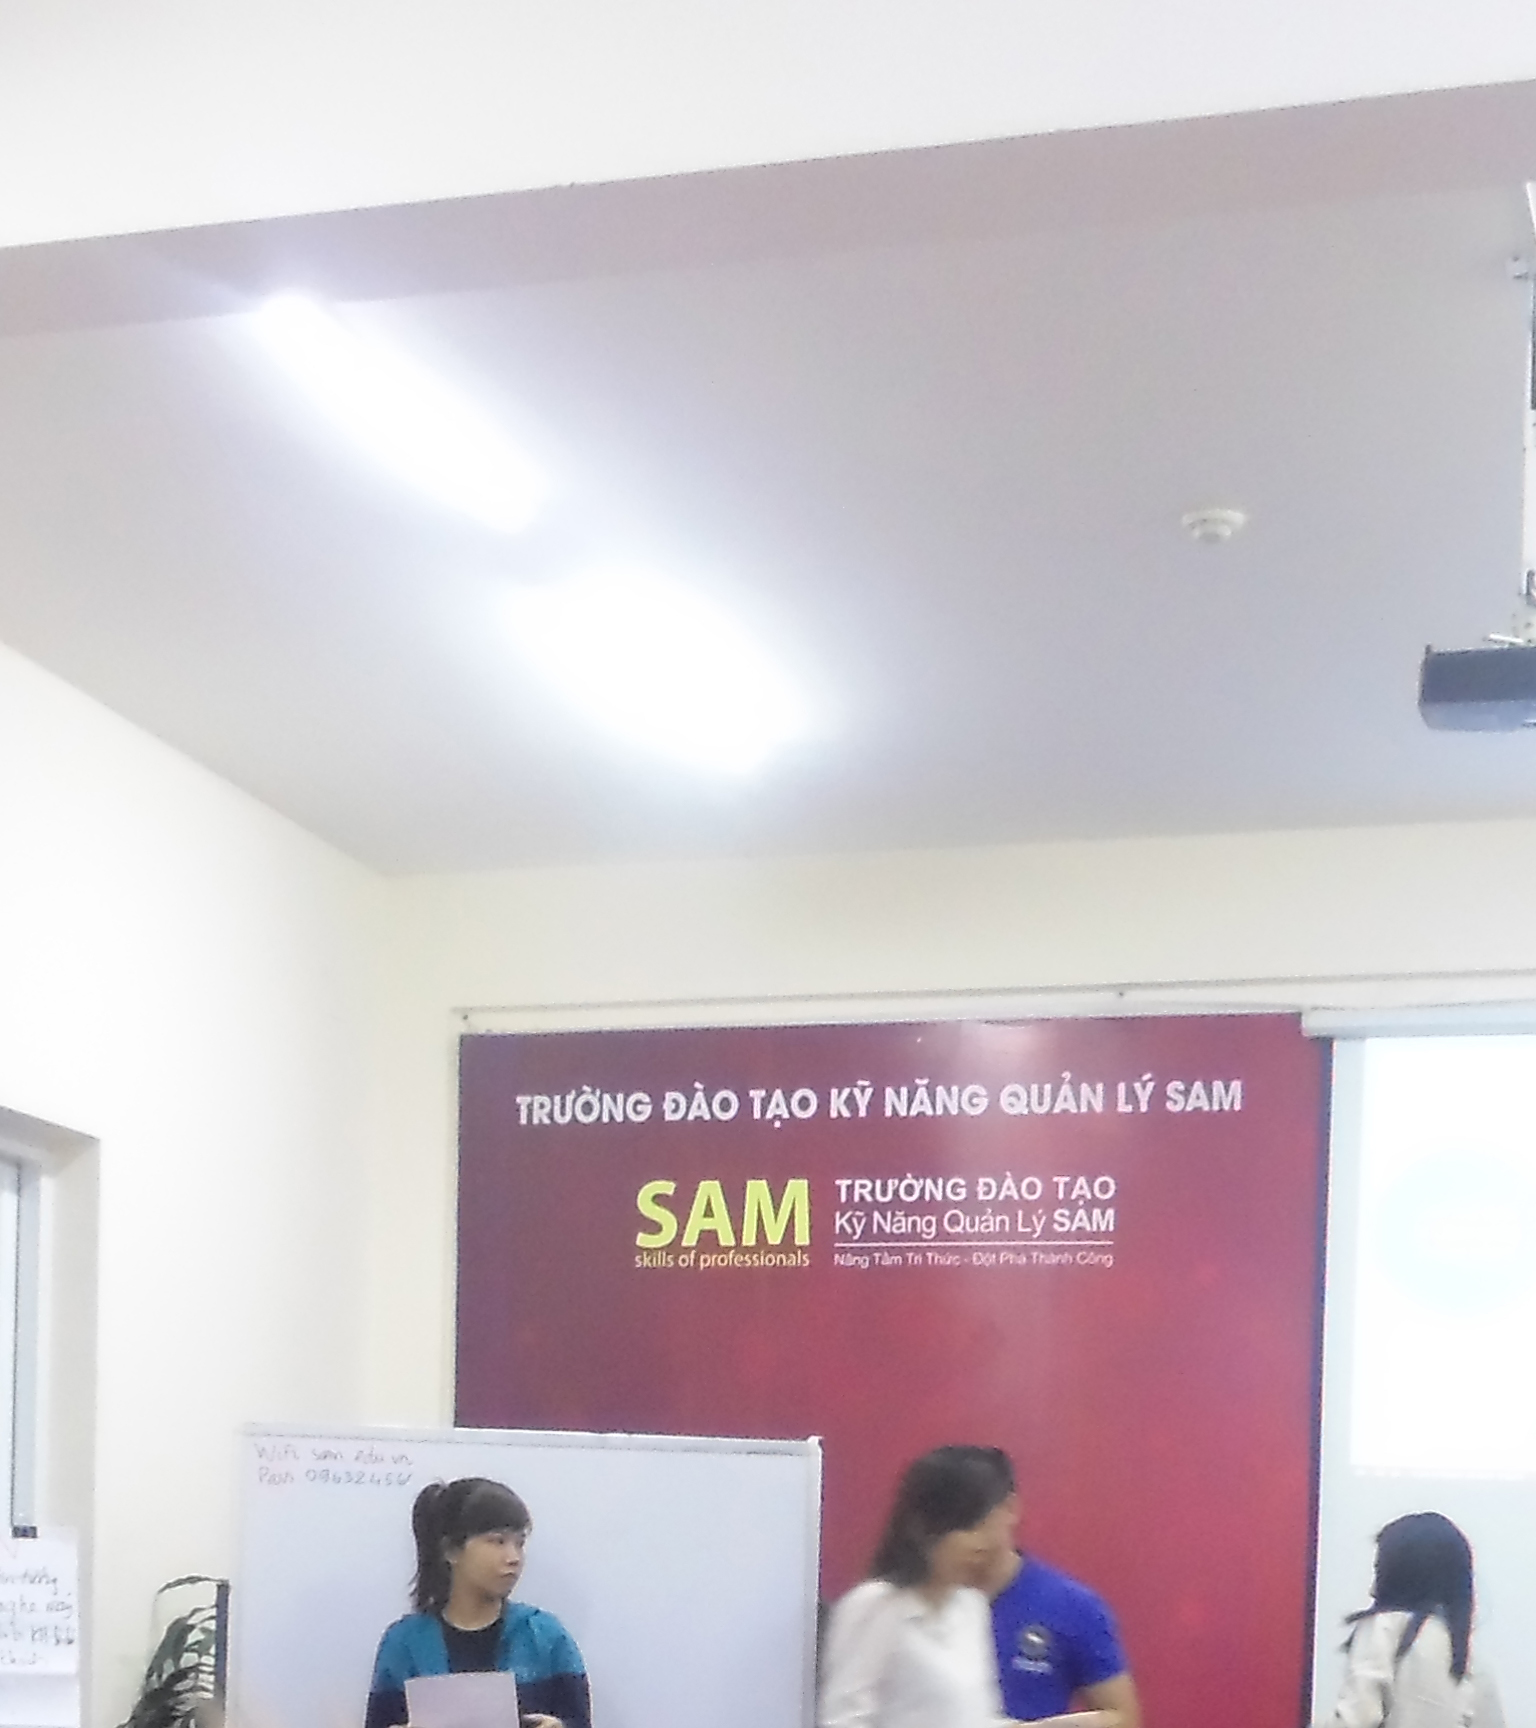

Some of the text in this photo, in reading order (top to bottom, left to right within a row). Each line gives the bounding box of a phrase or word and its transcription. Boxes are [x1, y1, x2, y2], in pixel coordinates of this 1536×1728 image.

[516, 1072, 1242, 1128] TRƯỜNG ĐÀO TẠO KỸ NĂNG QUẢN LÝ SAM
[835, 1172, 1116, 1205] TRƯỜNG ĐÀO TẠO
[636, 1179, 810, 1248] SAM
[835, 1208, 1115, 1239] Kỹ Năng Quản Lý SAM
[635, 1250, 810, 1270] skills of professionals
